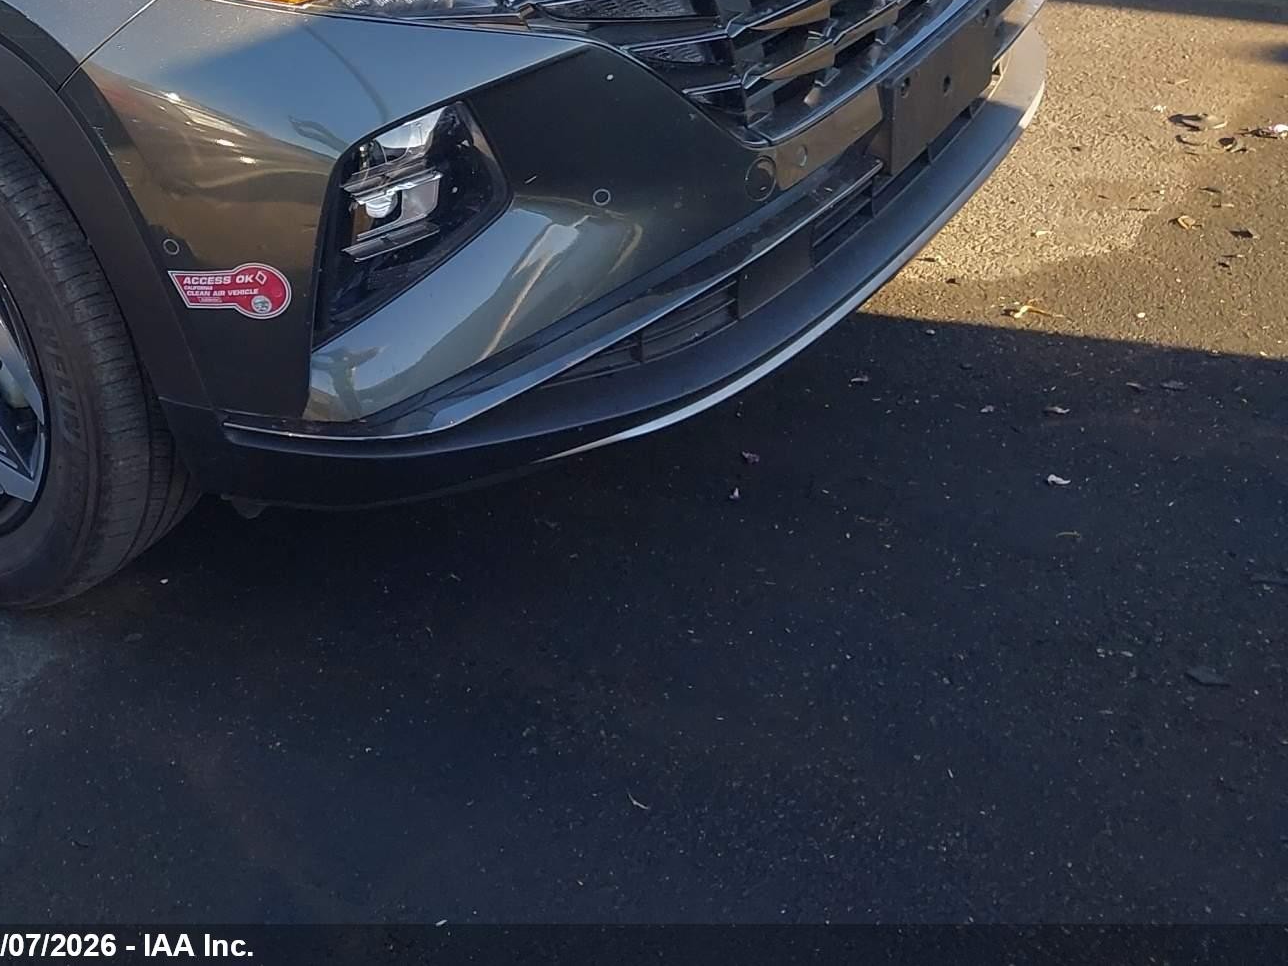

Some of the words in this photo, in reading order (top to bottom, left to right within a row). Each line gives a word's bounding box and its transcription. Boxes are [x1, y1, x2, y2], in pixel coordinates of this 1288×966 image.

[183, 276, 232, 285] ACCESS
[235, 274, 254, 284] OK
[227, 288, 259, 296] VEHICLE
